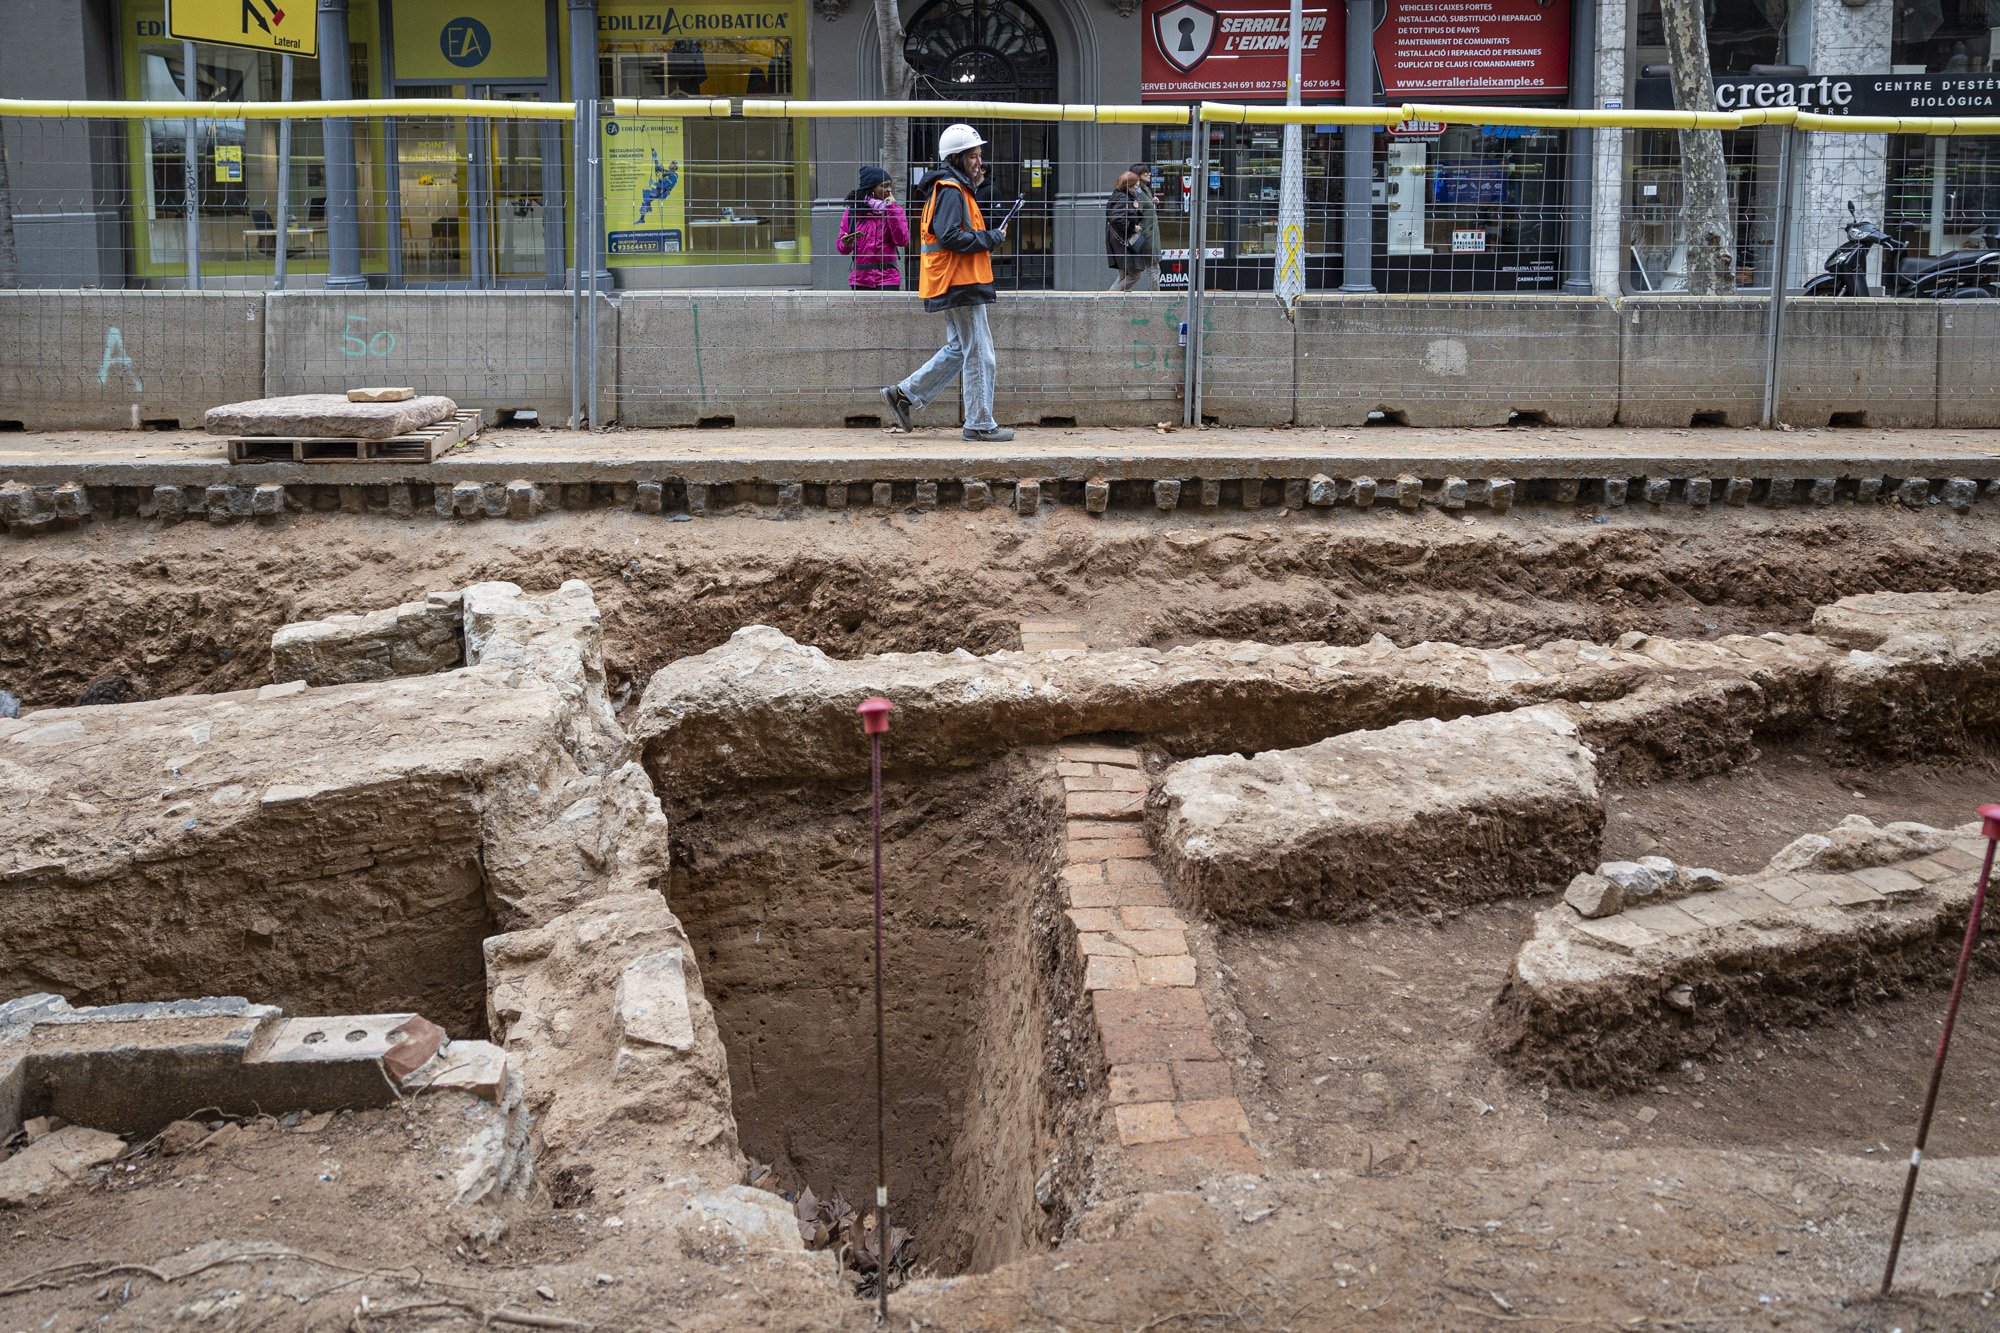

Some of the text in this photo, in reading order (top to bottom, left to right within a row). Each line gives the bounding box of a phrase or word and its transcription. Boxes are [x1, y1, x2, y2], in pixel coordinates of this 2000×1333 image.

[1465, 3, 1493, 11] FORTES
[1449, 14, 1497, 22] SUBSTITUCIÓ
[1501, 13, 1542, 22] REPARACIÓ
[1220, 16, 1327, 33] SERRALLRIA
[1456, 26, 1480, 34] PANYS
[273, 35, 301, 49] Lateral
[448, 27, 482, 57] EA
[1224, 34, 1322, 51] L'EIXAMLE
[1398, 38, 1452, 46] MANTENIMENT
[1463, 37, 1510, 45] COMUNITATS
[1451, 48, 1491, 56] REPARACIÓ
[1503, 48, 1542, 56] PERSIANES
[1168, 81, 1222, 90] D'URGÈNCIES
[1222, 81, 1239, 89] 24H
[1240, 81, 1255, 89] 691
[1256, 80, 1271, 88] 802
[1272, 80, 1287, 88] 758
[1330, 79, 1340, 87] 94
[1396, 76, 1545, 88] www.serrallerialeixample.es
[1874, 81, 1932, 91] CENTRE
[1715, 76, 1852, 108] crearte
[1911, 94, 1992, 107] BIOLÒGICA
[1395, 120, 1439, 131] ABUS
[1159, 273, 1189, 283] ABMA
[97, 326, 143, 392] A
